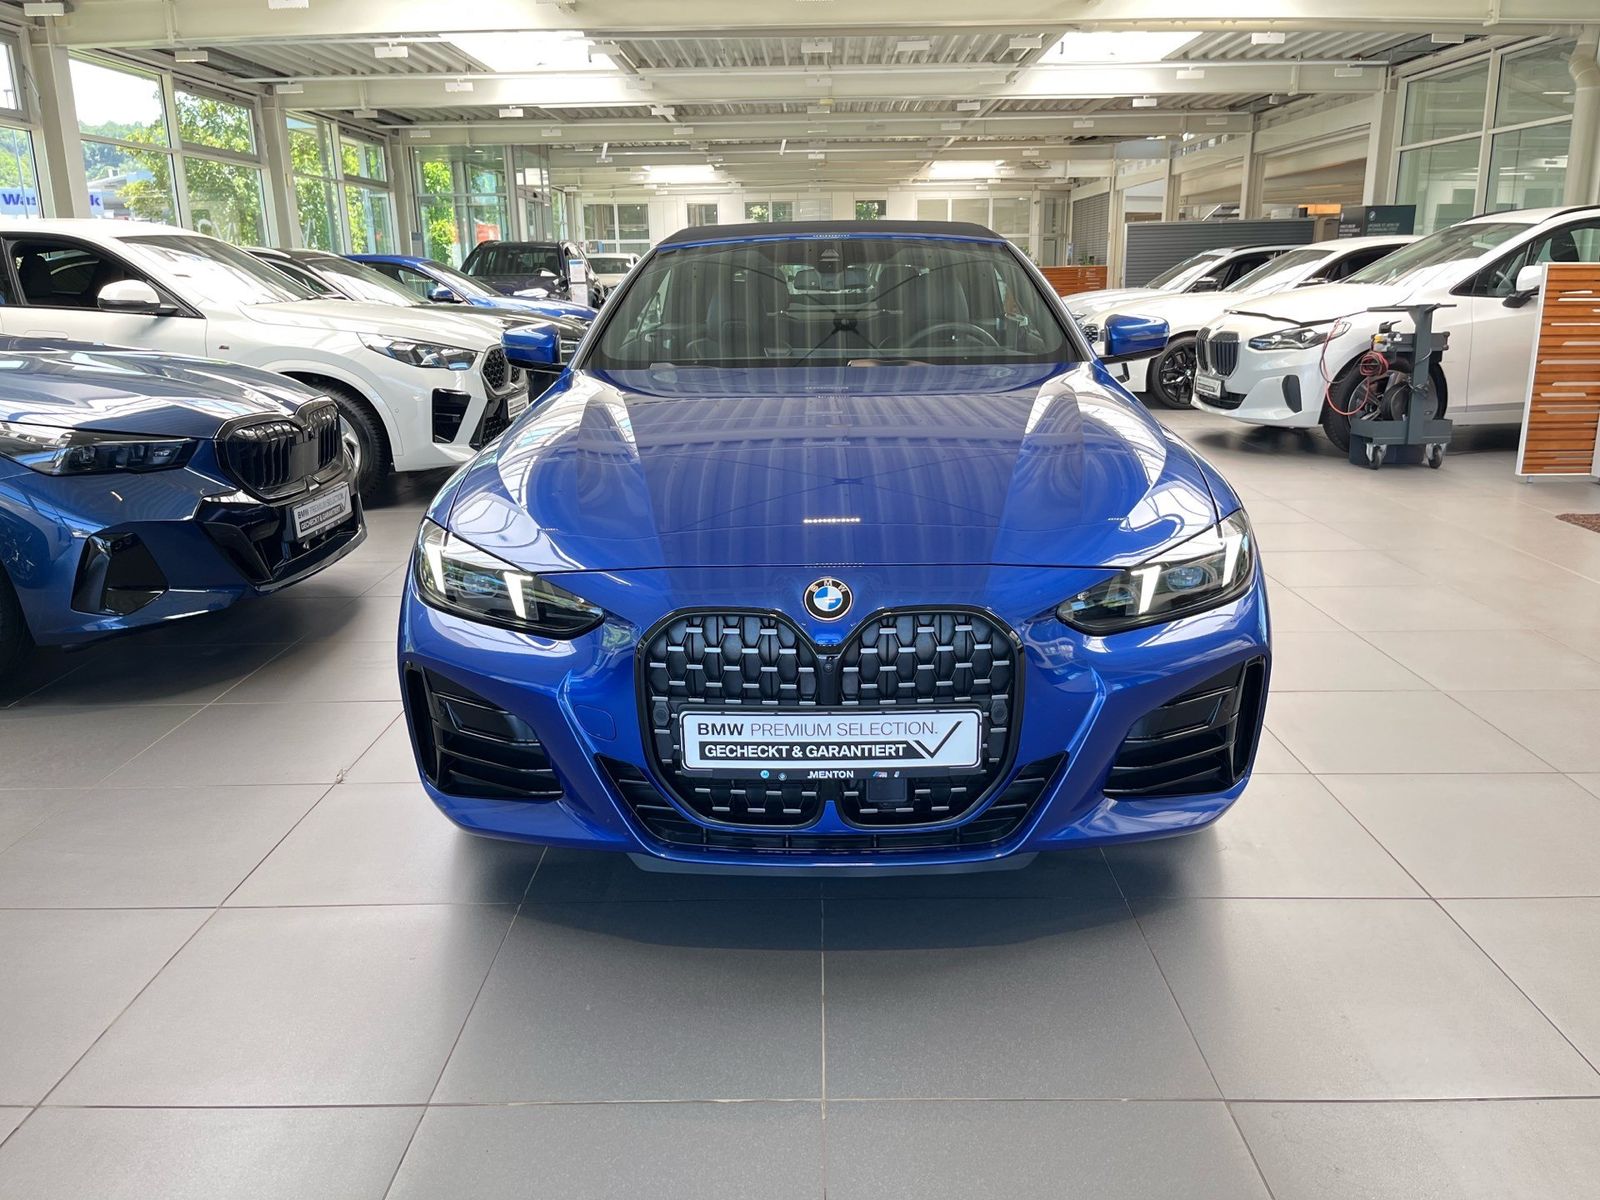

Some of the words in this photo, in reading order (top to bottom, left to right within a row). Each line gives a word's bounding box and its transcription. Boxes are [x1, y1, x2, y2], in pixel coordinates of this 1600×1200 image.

[810, 579, 848, 592] BMW
[697, 723, 744, 736] BMW
[751, 723, 832, 737] PREMIUM
[836, 721, 938, 736] SELECTION.
[704, 744, 789, 758] GECHECKT
[791, 745, 803, 758] &
[806, 744, 907, 758] GARANTIERT
